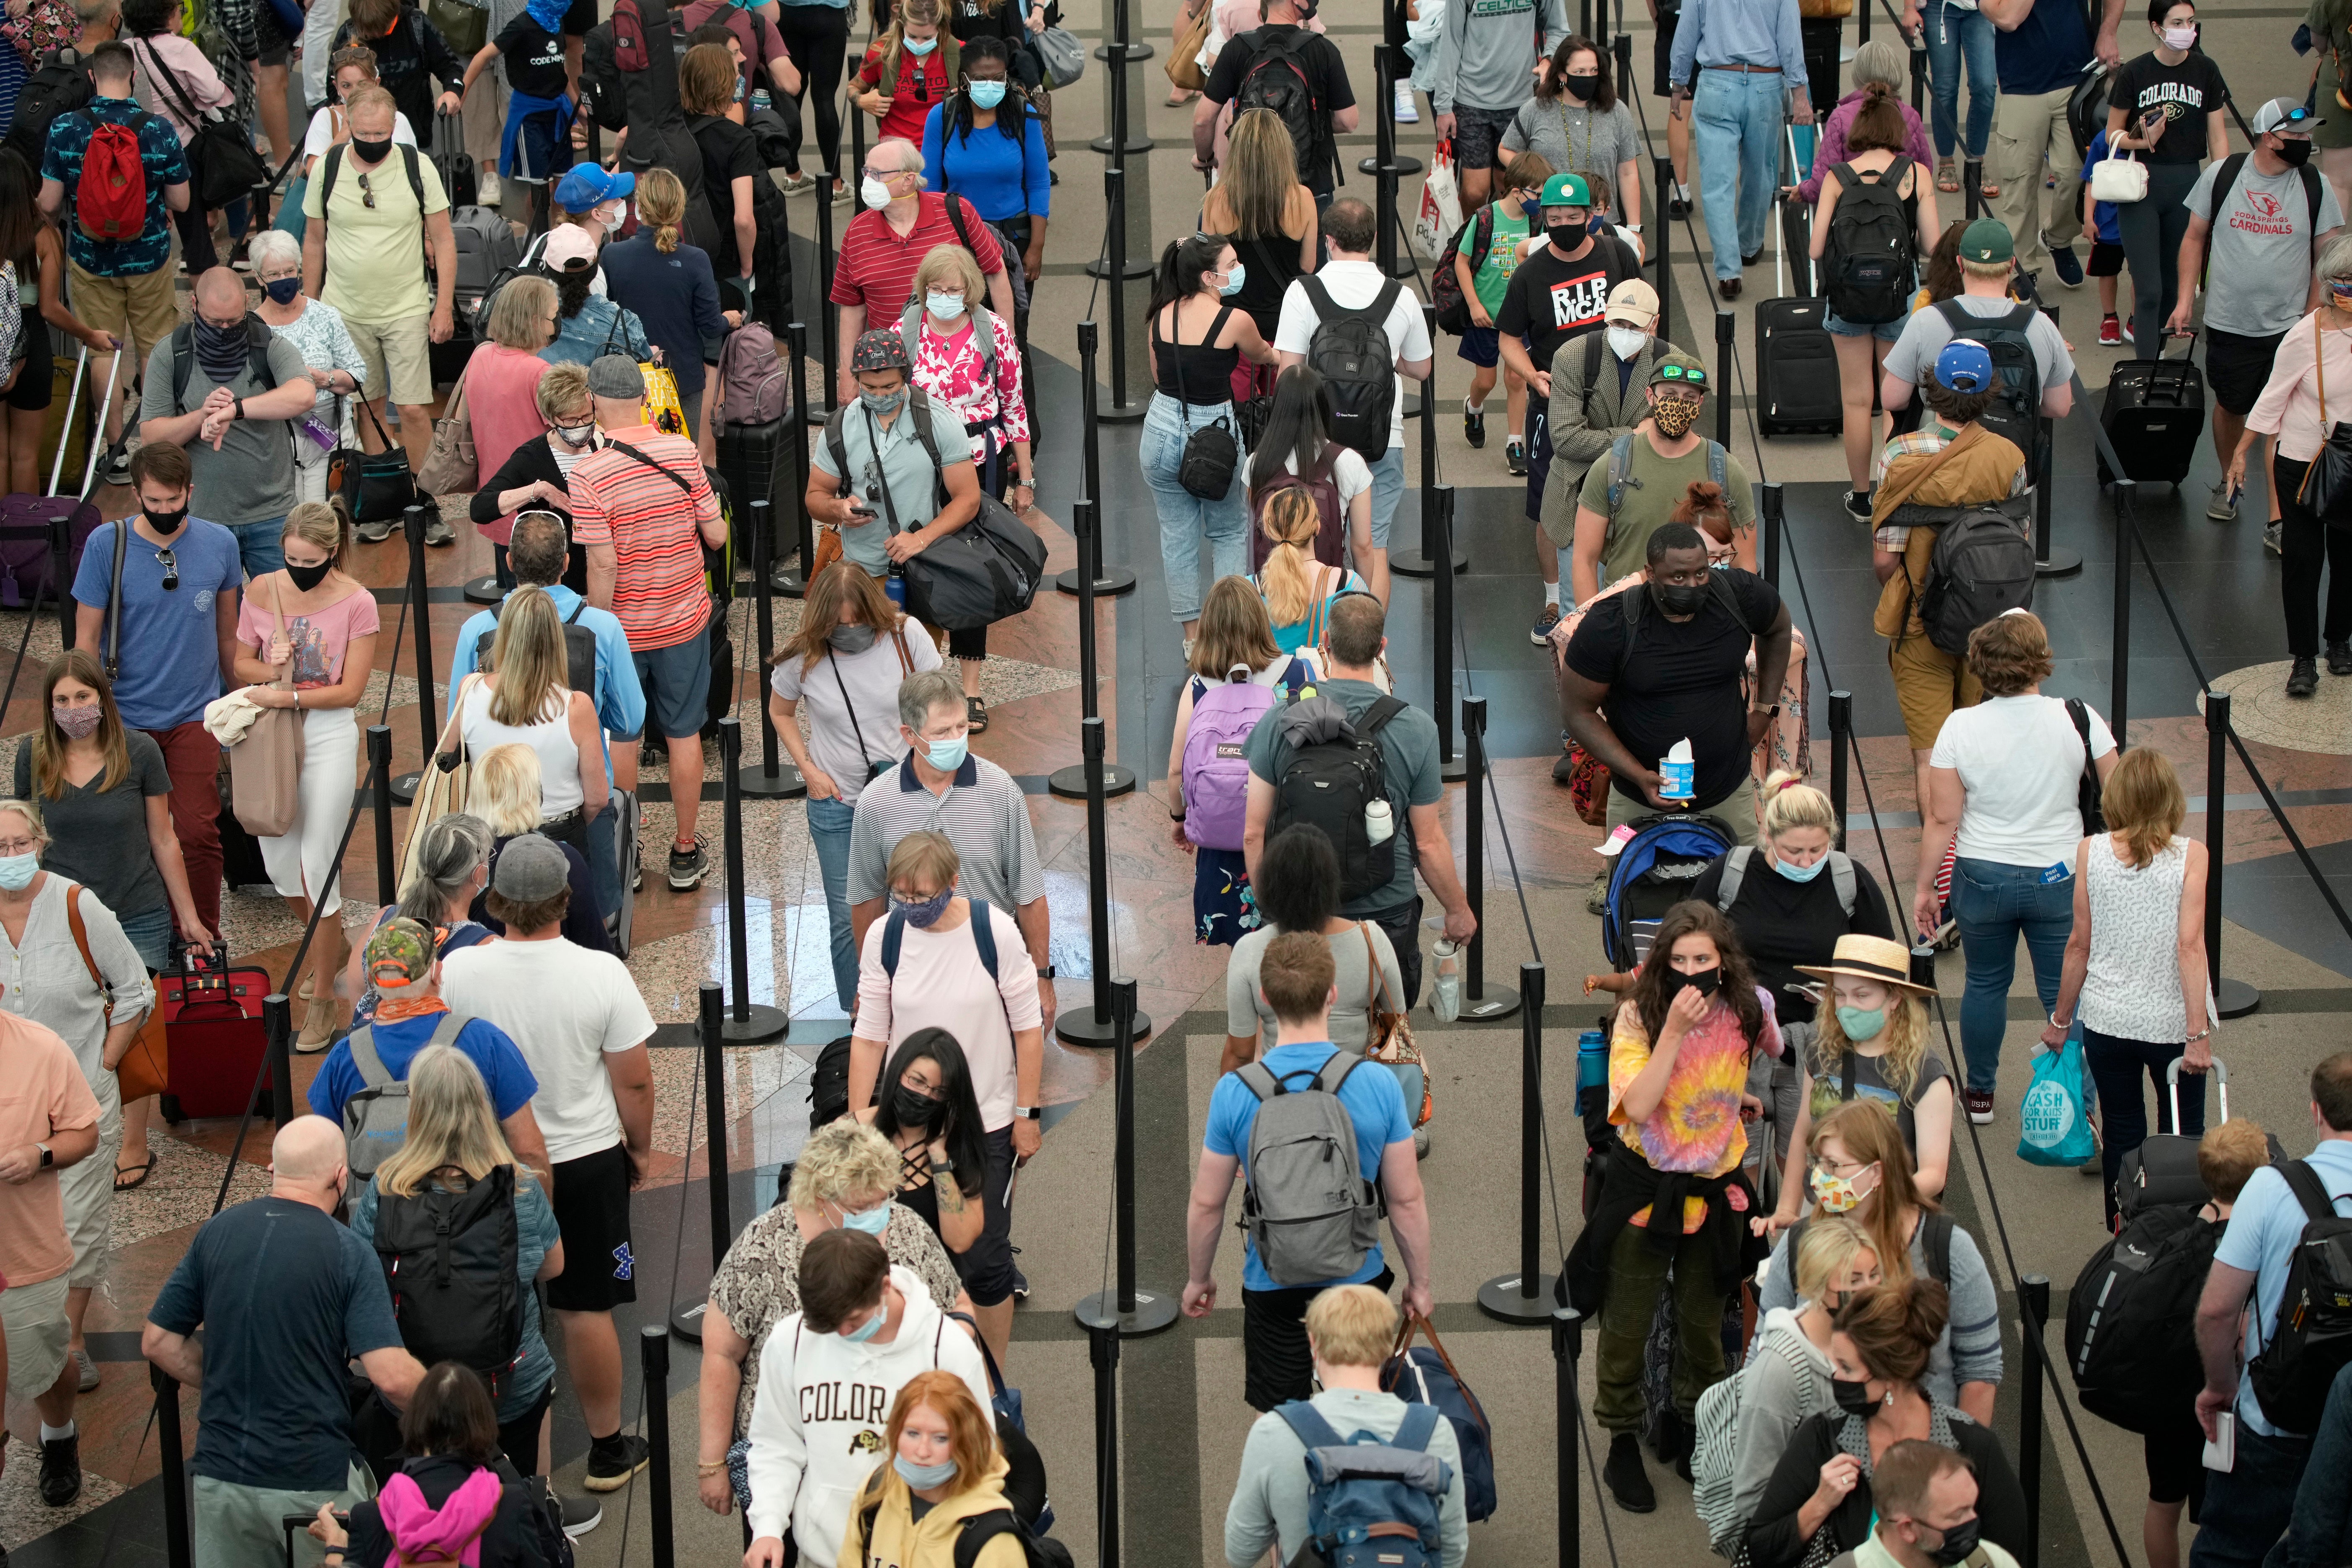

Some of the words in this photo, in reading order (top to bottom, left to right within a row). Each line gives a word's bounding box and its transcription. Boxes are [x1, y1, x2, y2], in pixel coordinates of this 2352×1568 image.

[1477, 0, 1534, 12] CELTICS
[530, 56, 551, 65] CODE
[580, 95, 592, 105] USA
[2138, 82, 2202, 108] COLORADO
[2234, 211, 2256, 221] SODA
[2257, 213, 2289, 223] SPRINGS
[2229, 218, 2293, 235] CARDINALS
[1551, 277, 1607, 309] R.I.P.
[1554, 296, 1607, 326] MCA
[2045, 868, 2058, 877] Peel
[2047, 873, 2061, 883] Here
[2027, 1093, 2063, 1108] CASH
[2025, 1108, 2040, 1117] FOR
[2024, 1118, 2061, 1131] STUFF
[800, 1382, 890, 1424] COLOR
